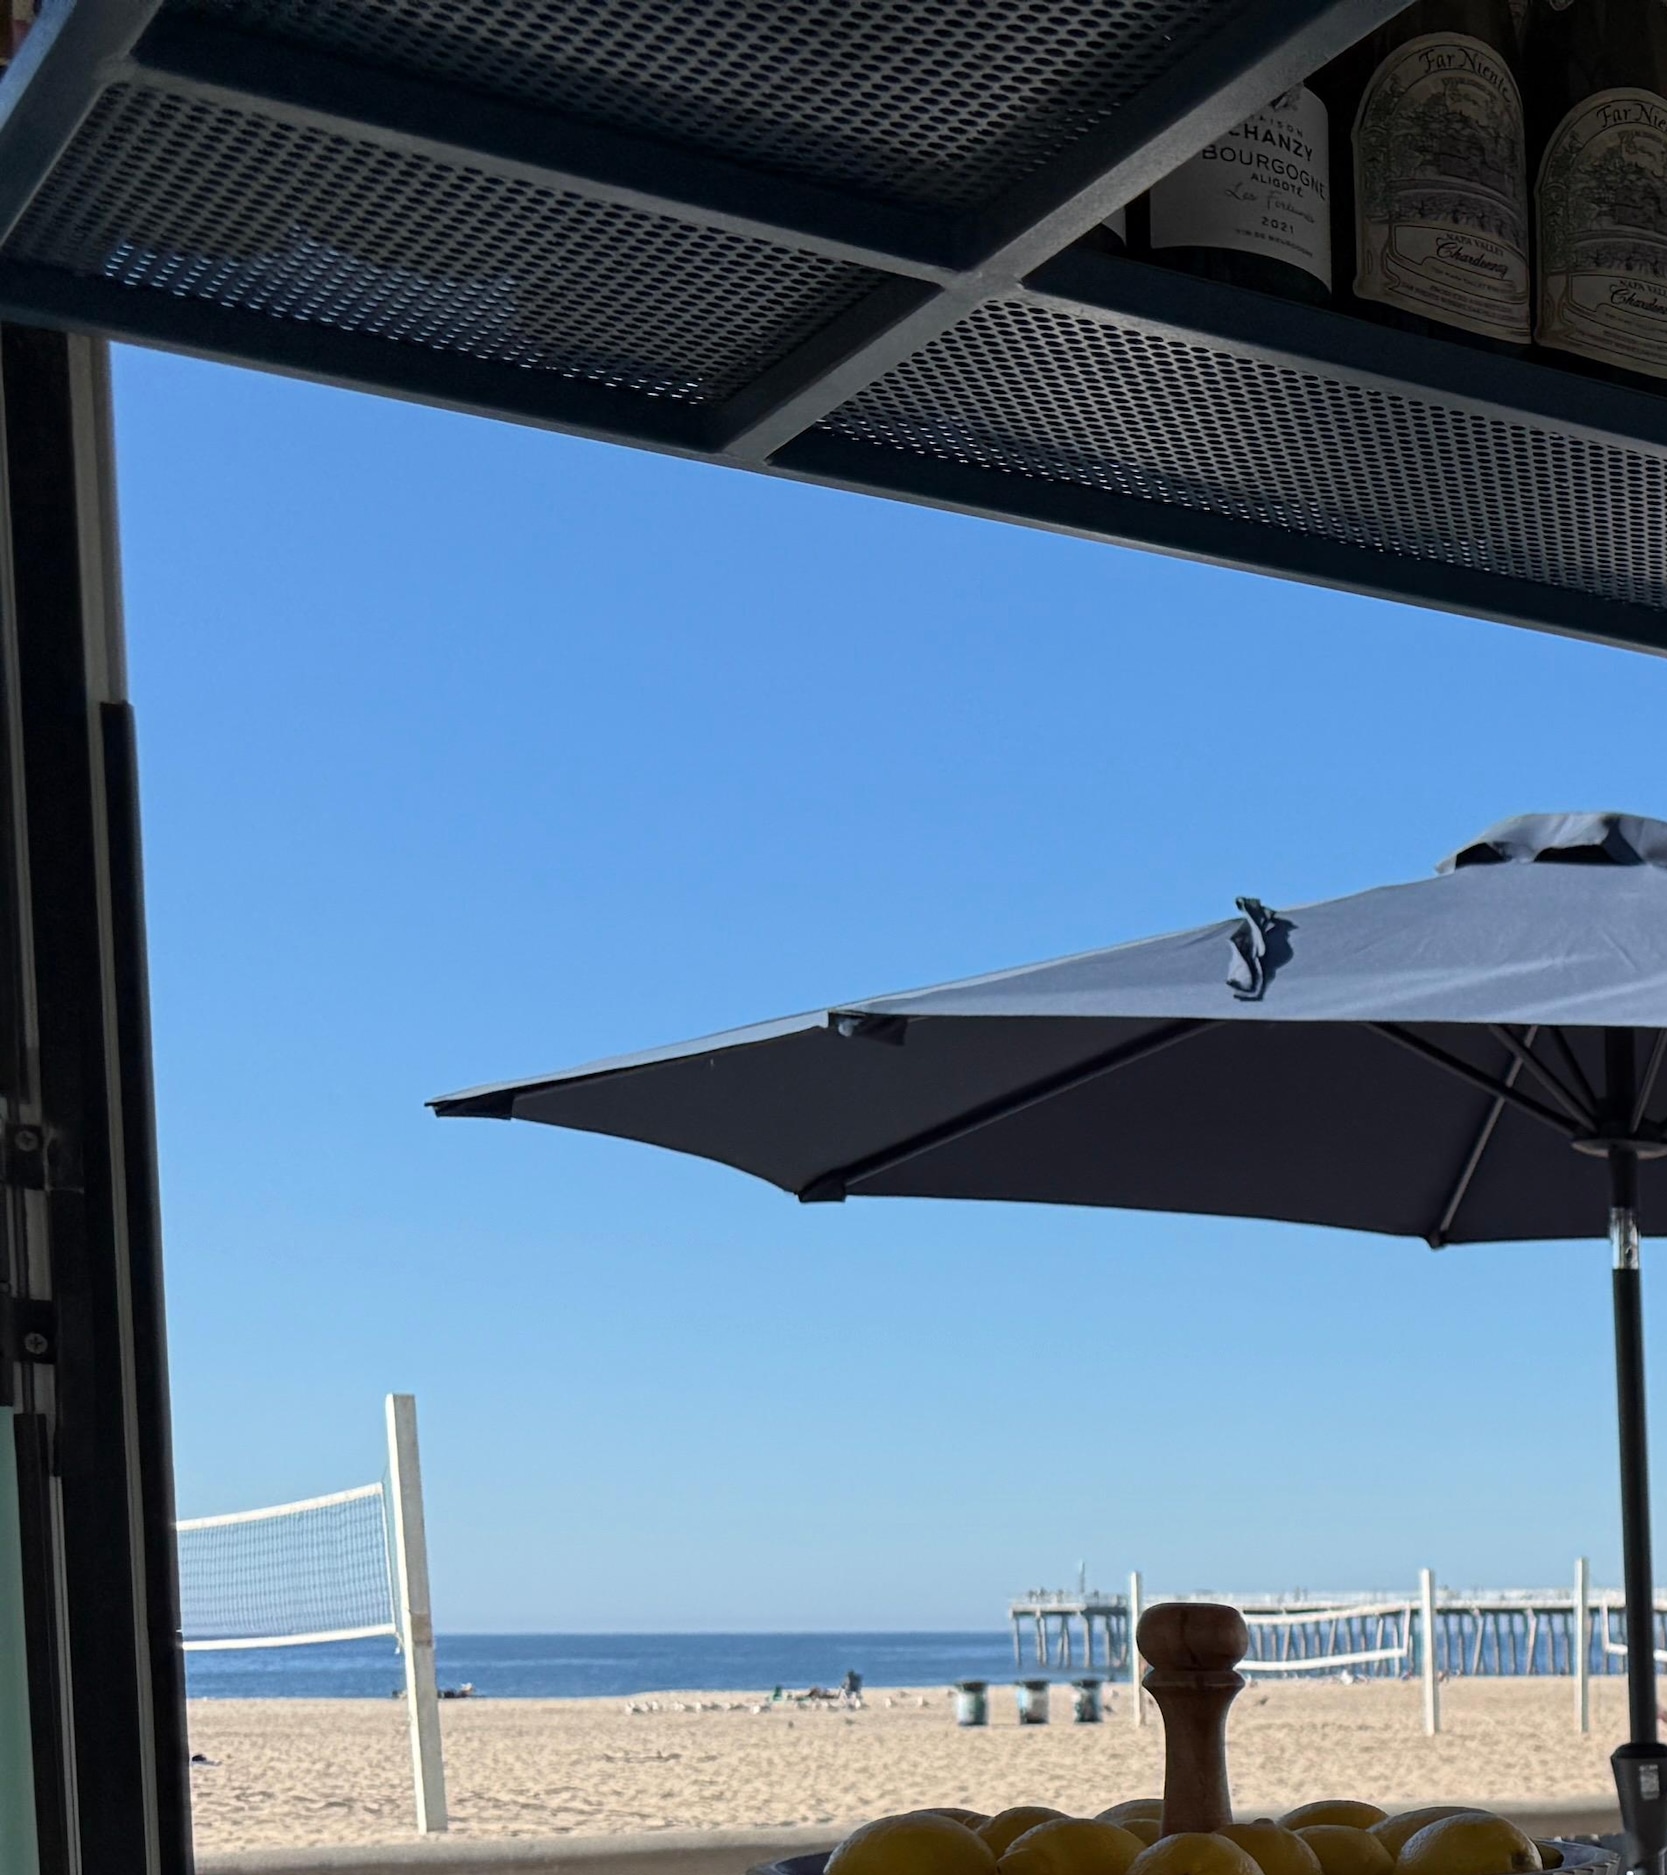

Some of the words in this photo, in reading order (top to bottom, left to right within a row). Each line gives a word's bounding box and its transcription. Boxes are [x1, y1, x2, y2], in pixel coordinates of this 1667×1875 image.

[1419, 49, 1456, 73] Far
[1459, 48, 1511, 103] Niente
[1596, 105, 1631, 128] Far
[1262, 217, 1295, 234] 2021
